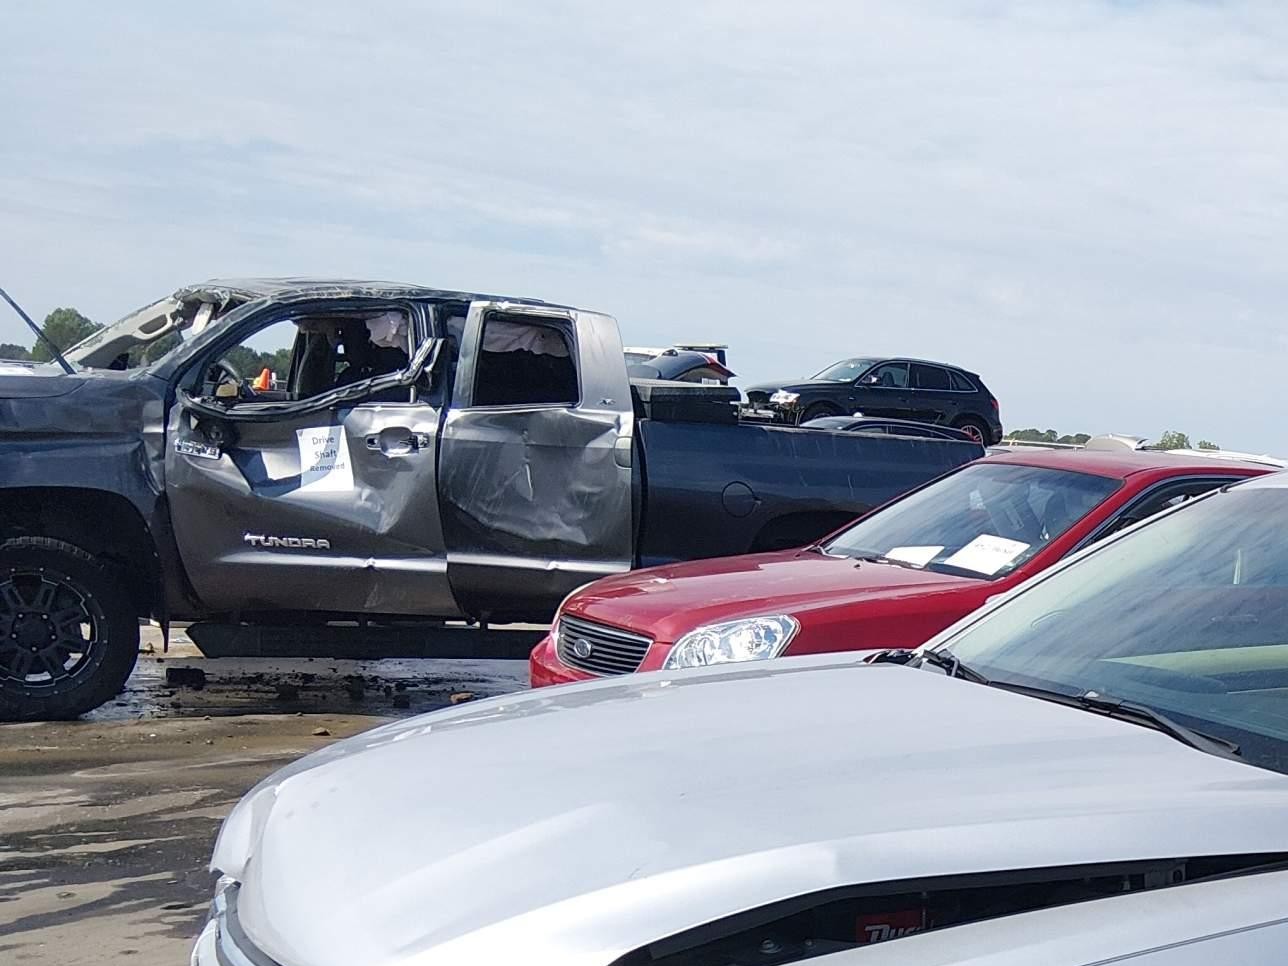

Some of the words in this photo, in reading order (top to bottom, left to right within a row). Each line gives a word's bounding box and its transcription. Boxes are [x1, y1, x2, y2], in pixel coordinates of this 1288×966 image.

[312, 436, 335, 445] Drive
[314, 450, 337, 459] Shaft
[310, 462, 345, 472] Removed
[244, 533, 331, 549] TUNDRA
